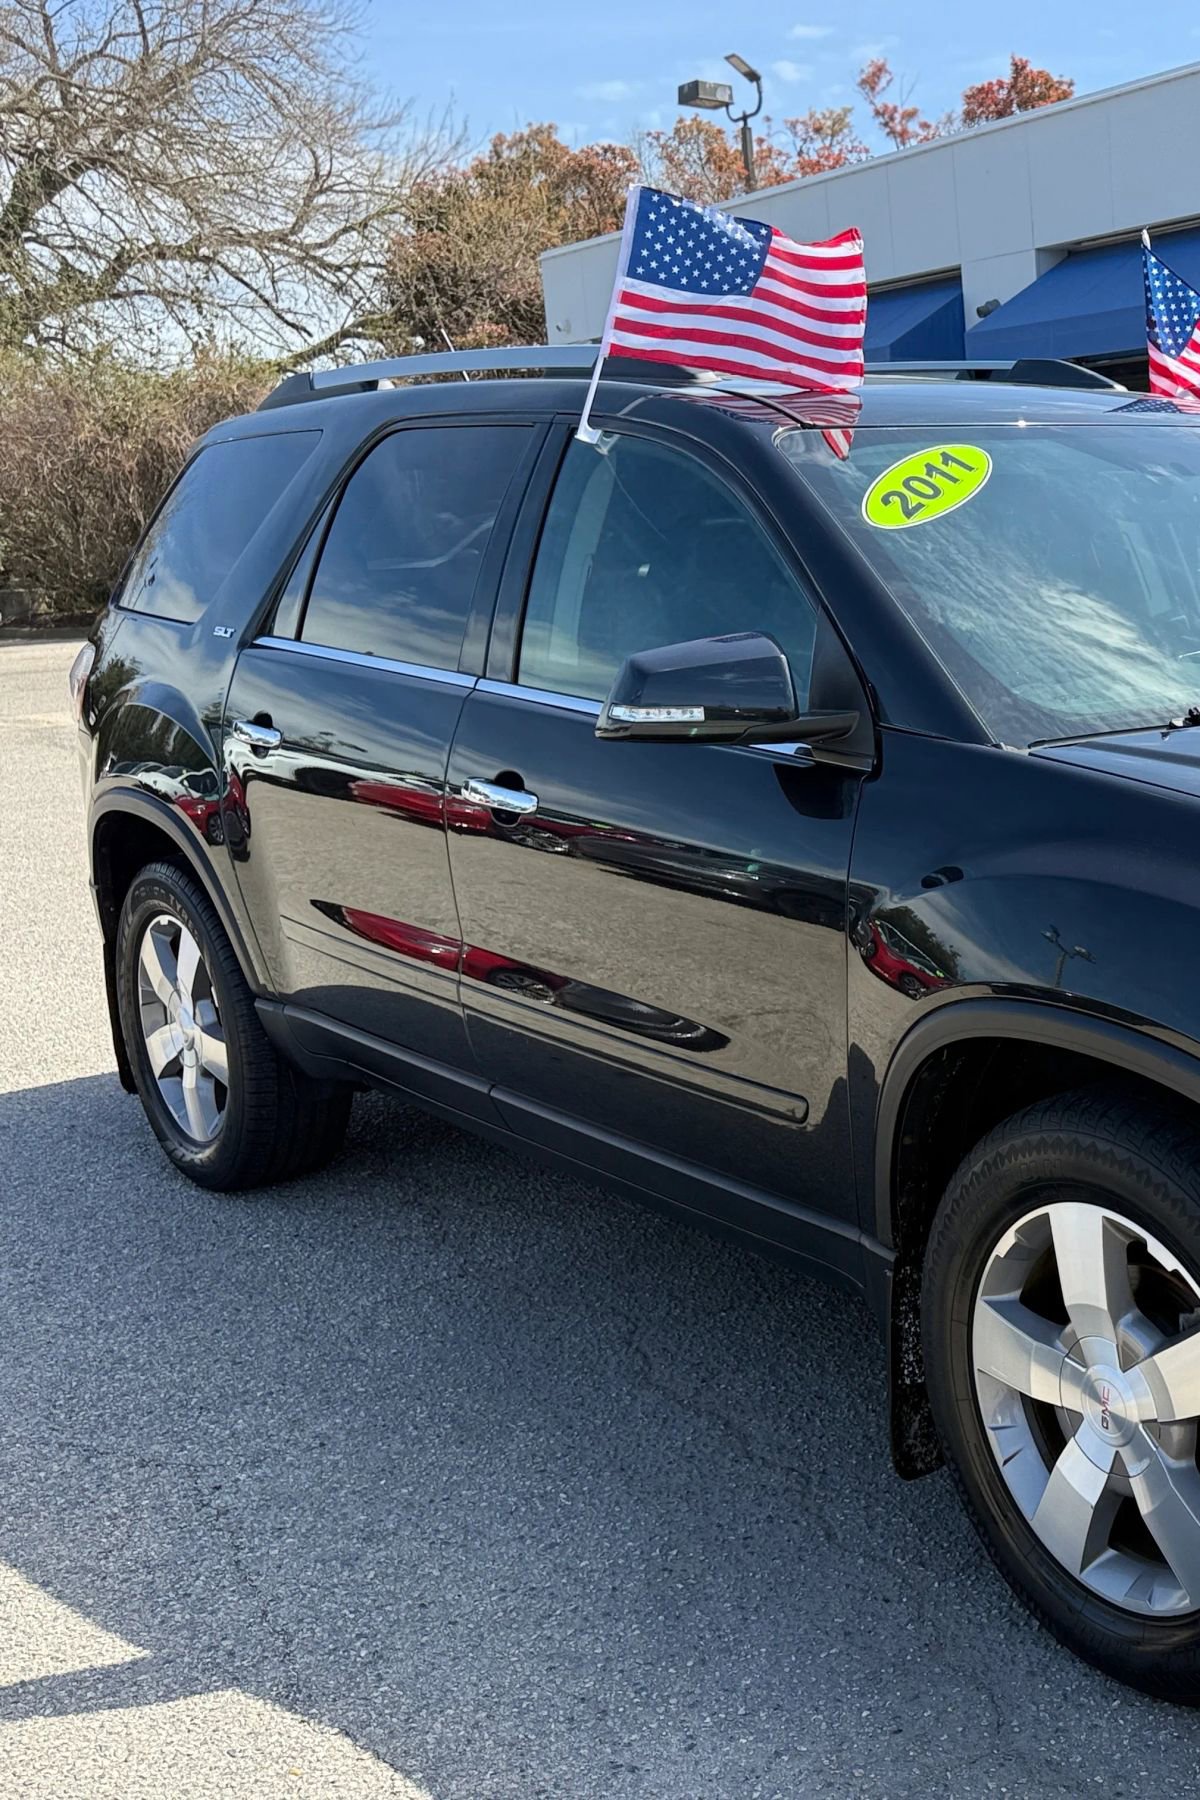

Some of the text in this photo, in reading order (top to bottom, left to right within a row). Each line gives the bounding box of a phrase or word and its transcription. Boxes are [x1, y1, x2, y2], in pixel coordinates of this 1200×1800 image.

[881, 451, 976, 520] 2011
[213, 626, 235, 638] SLT
[1101, 1386, 1110, 1430] GMC
